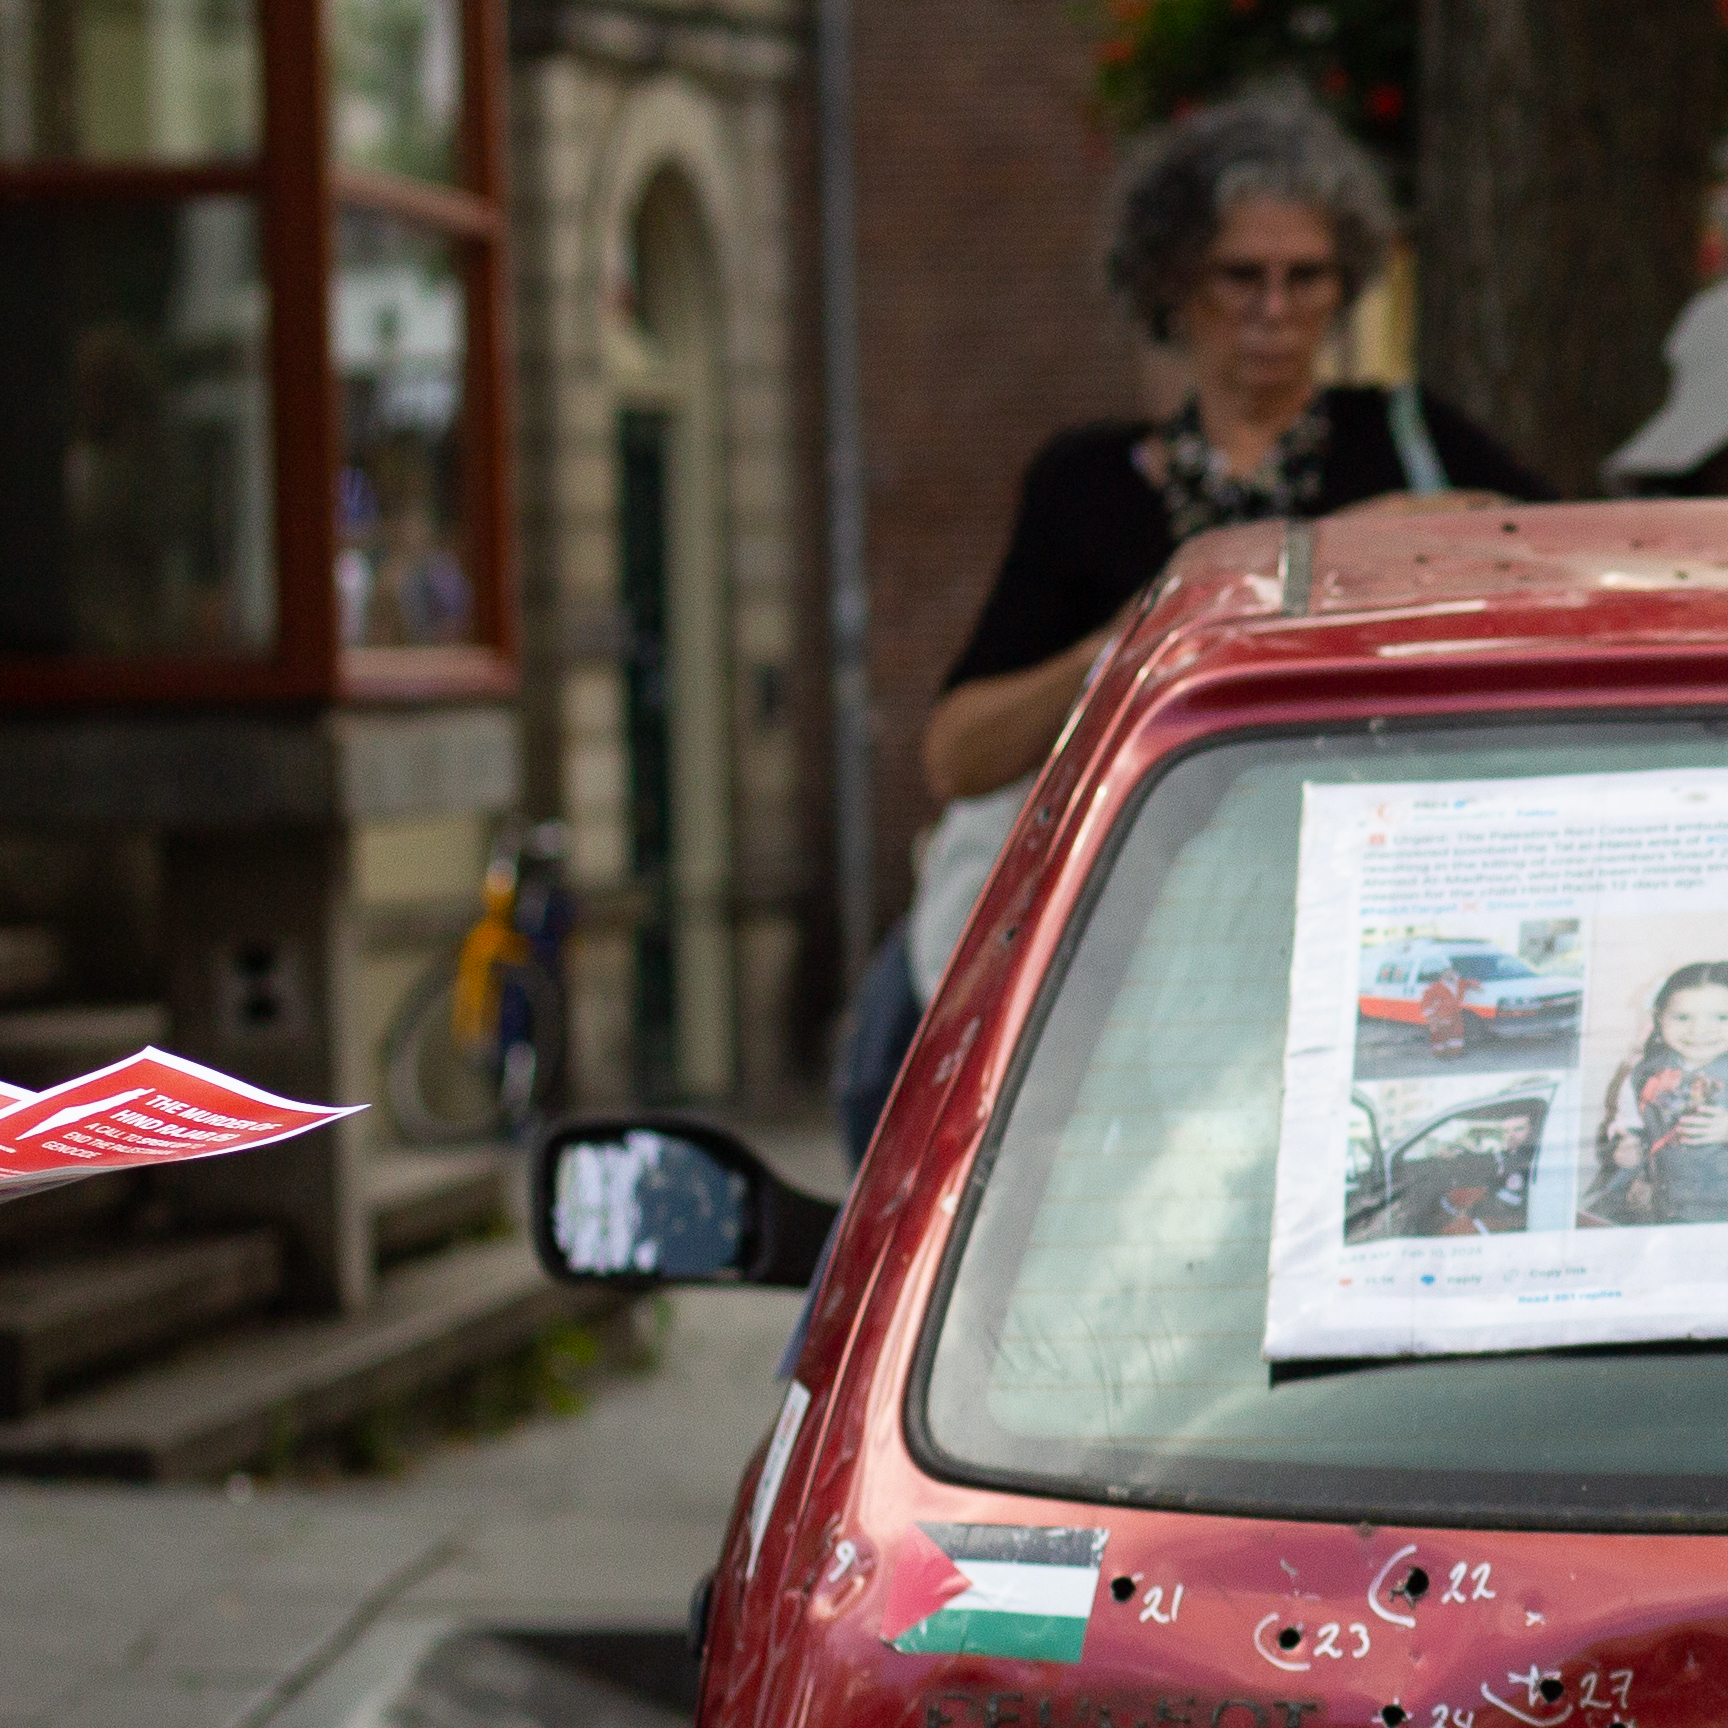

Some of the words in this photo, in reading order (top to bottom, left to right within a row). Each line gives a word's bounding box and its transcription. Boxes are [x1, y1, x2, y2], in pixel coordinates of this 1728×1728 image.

[110, 1109, 163, 1130] HIND
[154, 1122, 217, 1140] RAJAB
[145, 1095, 185, 1113] THE
[177, 1107, 252, 1129] MURDER
[62, 1131, 92, 1144] END
[87, 1138, 116, 1150] THE
[84, 1122, 100, 1130] A
[95, 1125, 126, 1139] CALL
[41, 1140, 103, 1159] GENOCIDE
[1441, 1560, 1497, 1604] 22
[1139, 1585, 1184, 1623] 21
[1313, 1622, 1371, 1659] 23
[1579, 1669, 1634, 1709] 27
